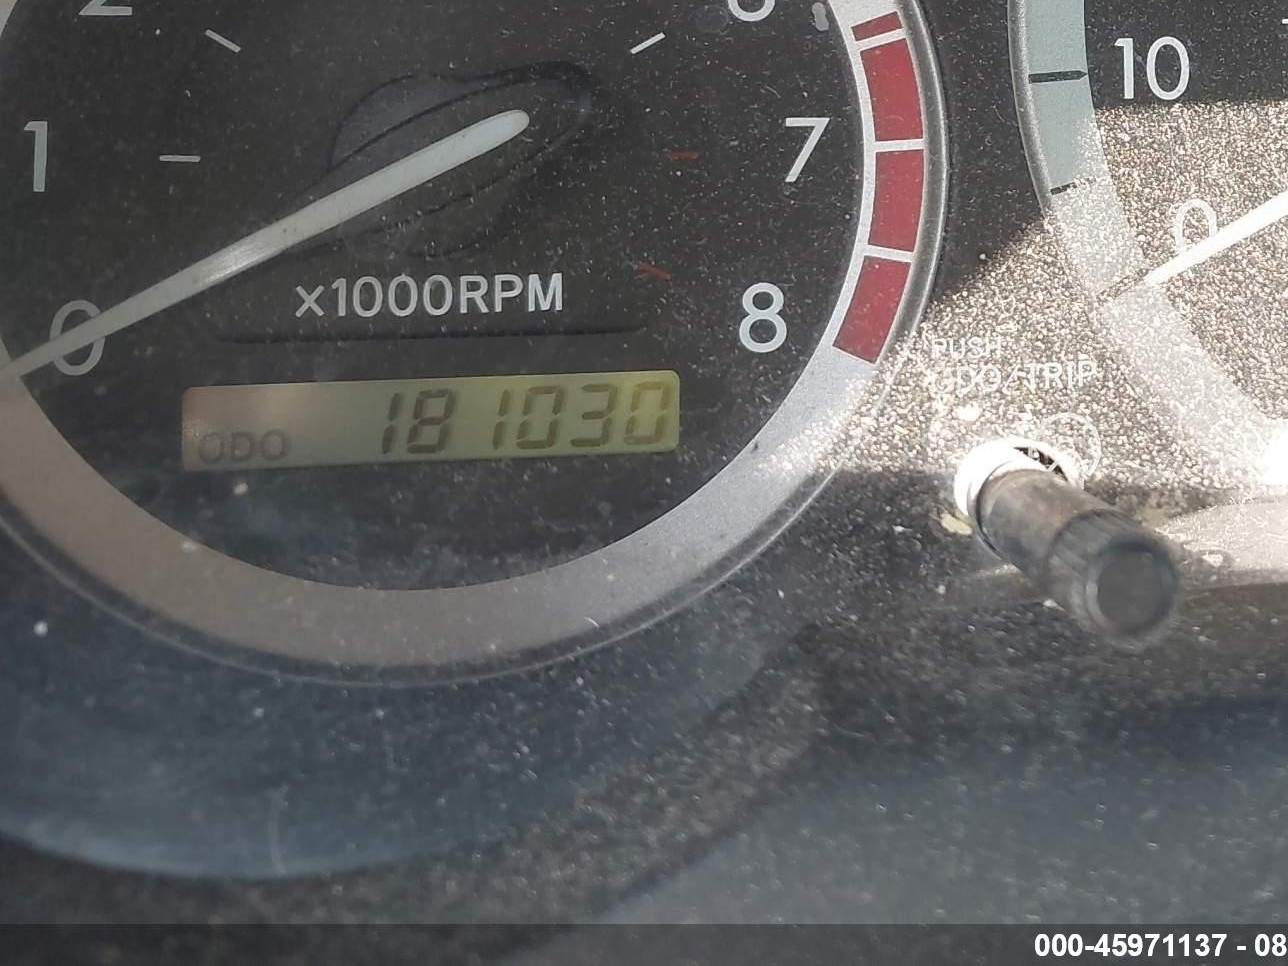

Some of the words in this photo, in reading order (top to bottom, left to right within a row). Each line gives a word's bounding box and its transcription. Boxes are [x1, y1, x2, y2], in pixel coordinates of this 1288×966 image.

[1114, 36, 1190, 101] 10
[24, 120, 48, 192] 1
[784, 118, 831, 183] 7
[294, 273, 565, 320] x1000RPM
[738, 282, 788, 352] 8
[50, 299, 106, 376] 0
[201, 430, 289, 465] ODO
[381, 381, 671, 455] 181030
